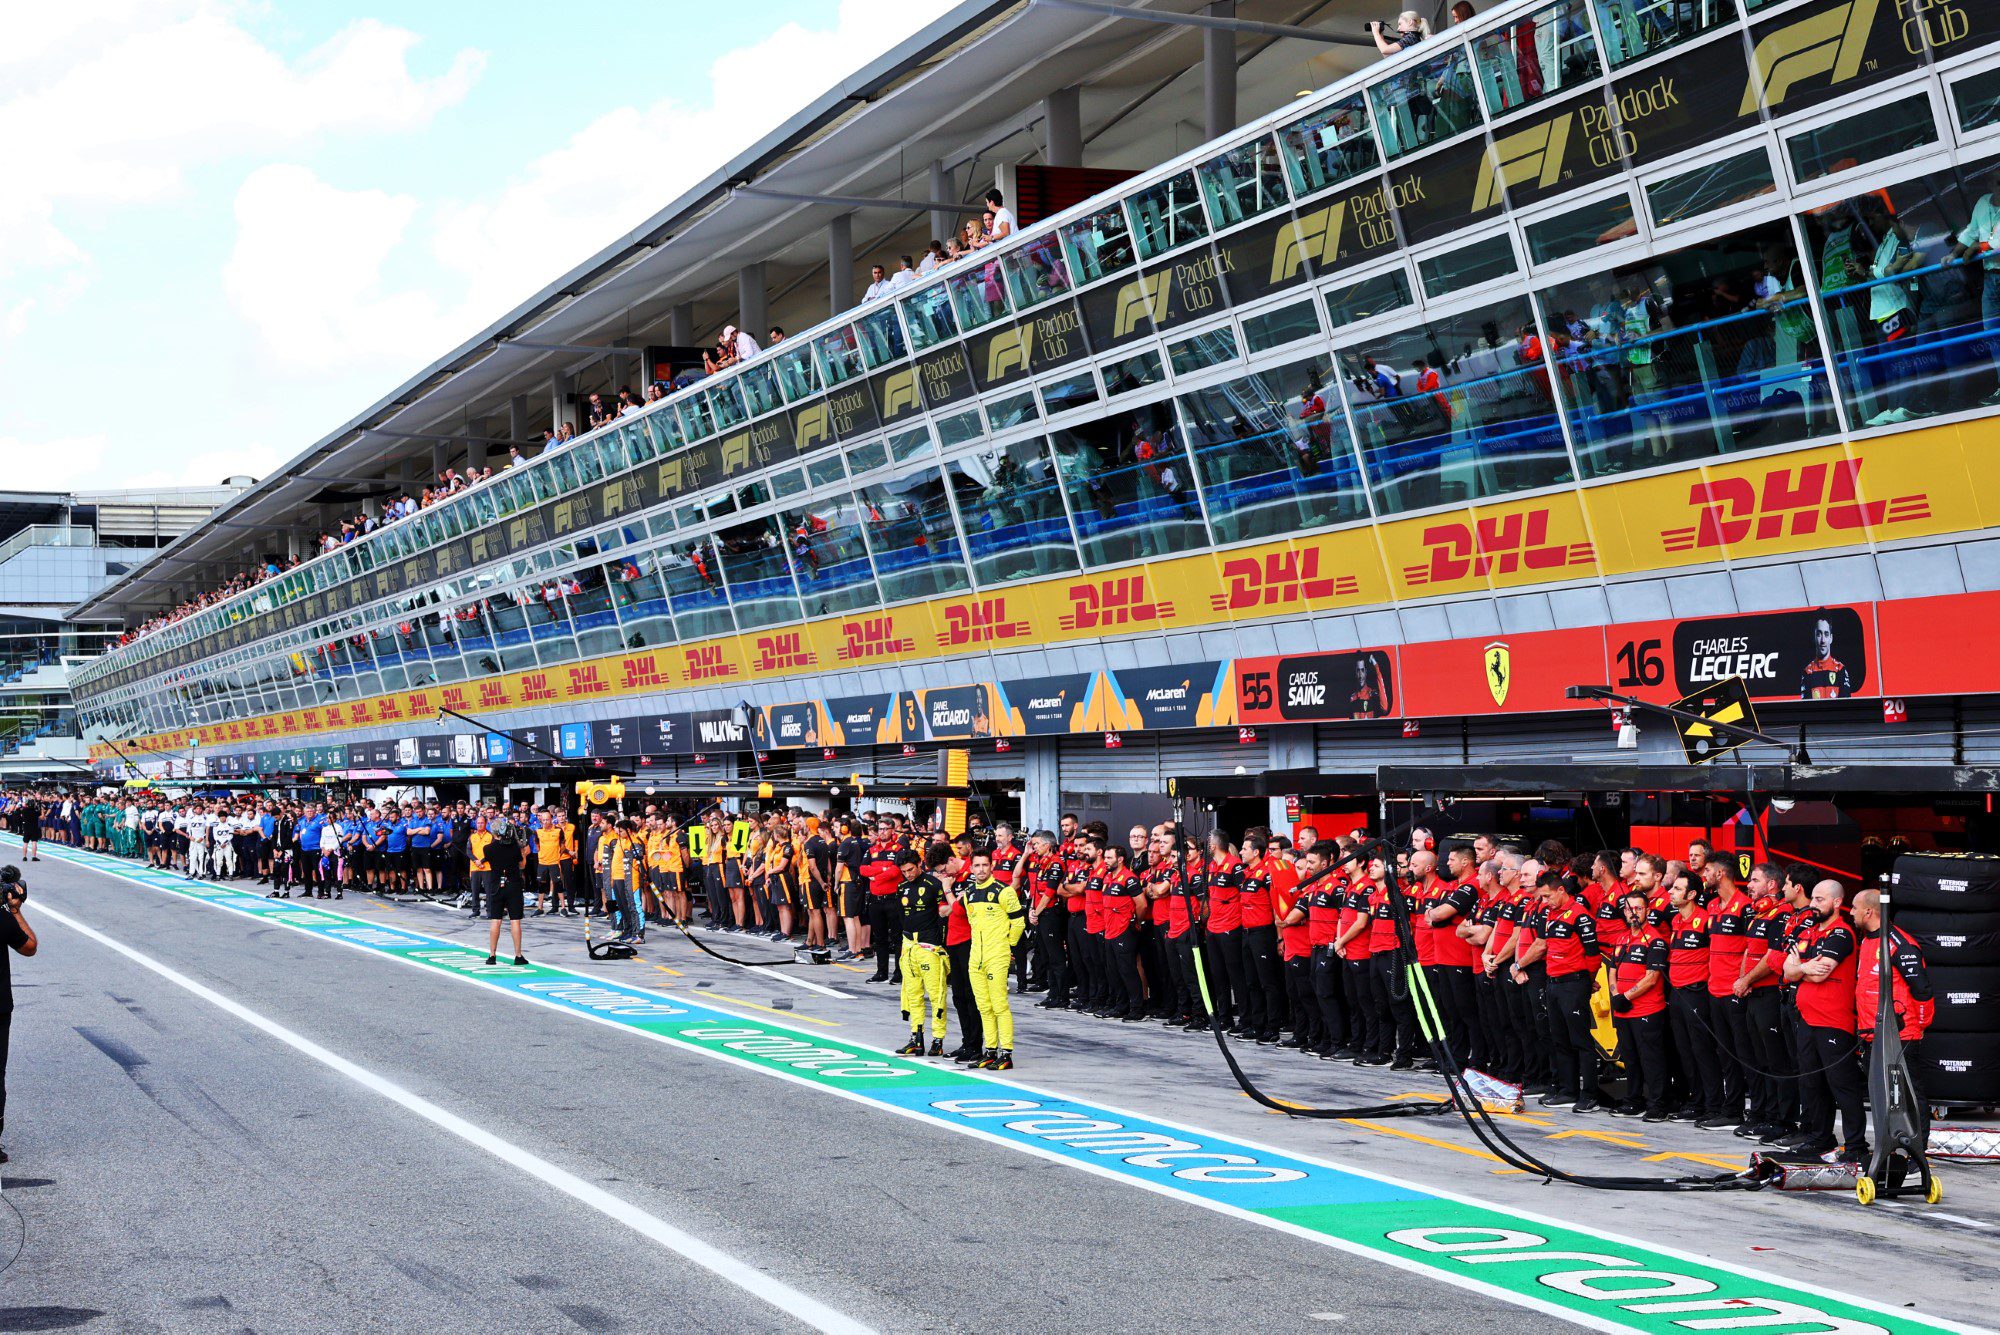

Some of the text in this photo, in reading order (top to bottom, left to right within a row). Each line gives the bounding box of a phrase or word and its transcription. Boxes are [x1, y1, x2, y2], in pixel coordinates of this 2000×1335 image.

[1902, 3, 1970, 56] Club
[1579, 75, 1679, 138] Paddock
[1471, 111, 1574, 213] F1
[1588, 129, 1639, 168] Club
[1350, 173, 1426, 224] Paddock
[1270, 200, 1347, 285] F1
[1358, 215, 1397, 250] Club
[1176, 248, 1236, 289] Paddock
[1113, 267, 1173, 339] F1
[1183, 283, 1214, 313] Club
[986, 321, 1034, 383] F1
[1042, 336, 1068, 361] Club
[924, 351, 964, 382] Paddock
[830, 389, 865, 418] Paddock
[929, 380, 951, 401] Club
[1690, 457, 1887, 549] DHL
[1422, 508, 1568, 583] DHL
[1223, 546, 1335, 610] DHL
[1069, 575, 1159, 630] DHL
[945, 597, 1018, 646] DHL
[756, 632, 810, 673] DHL
[842, 616, 904, 660] DHL
[1692, 636, 1749, 656] CHARLES
[623, 656, 661, 689] DHL
[685, 645, 730, 682] DHL
[1288, 671, 1319, 686] CARLOS
[1616, 639, 1665, 688] 16
[1689, 652, 1779, 682] LECLERC
[569, 665, 604, 695] DHL
[1145, 688, 1187, 701] McLaren
[1242, 671, 1273, 711] 55
[1287, 684, 1326, 707] SAINZ
[846, 714, 871, 724] McLaren
[905, 700, 916, 732] 3
[932, 708, 970, 727] RICCIARDO
[1028, 697, 1063, 710] McLaren
[1612, 711, 1623, 724] 2
[1884, 699, 1906, 715] 20
[757, 713, 765, 743] 4
[1106, 732, 1121, 744] 24
[1239, 727, 1256, 738] 23
[1403, 720, 1420, 732] 22
[823, 748, 836, 757] 27
[903, 744, 916, 753] 26
[996, 738, 1010, 748] 25
[677, 1027, 919, 1078] aramco
[1939, 1059, 1973, 1067] POSTERIORE
[928, 1098, 1309, 1184] aramco
